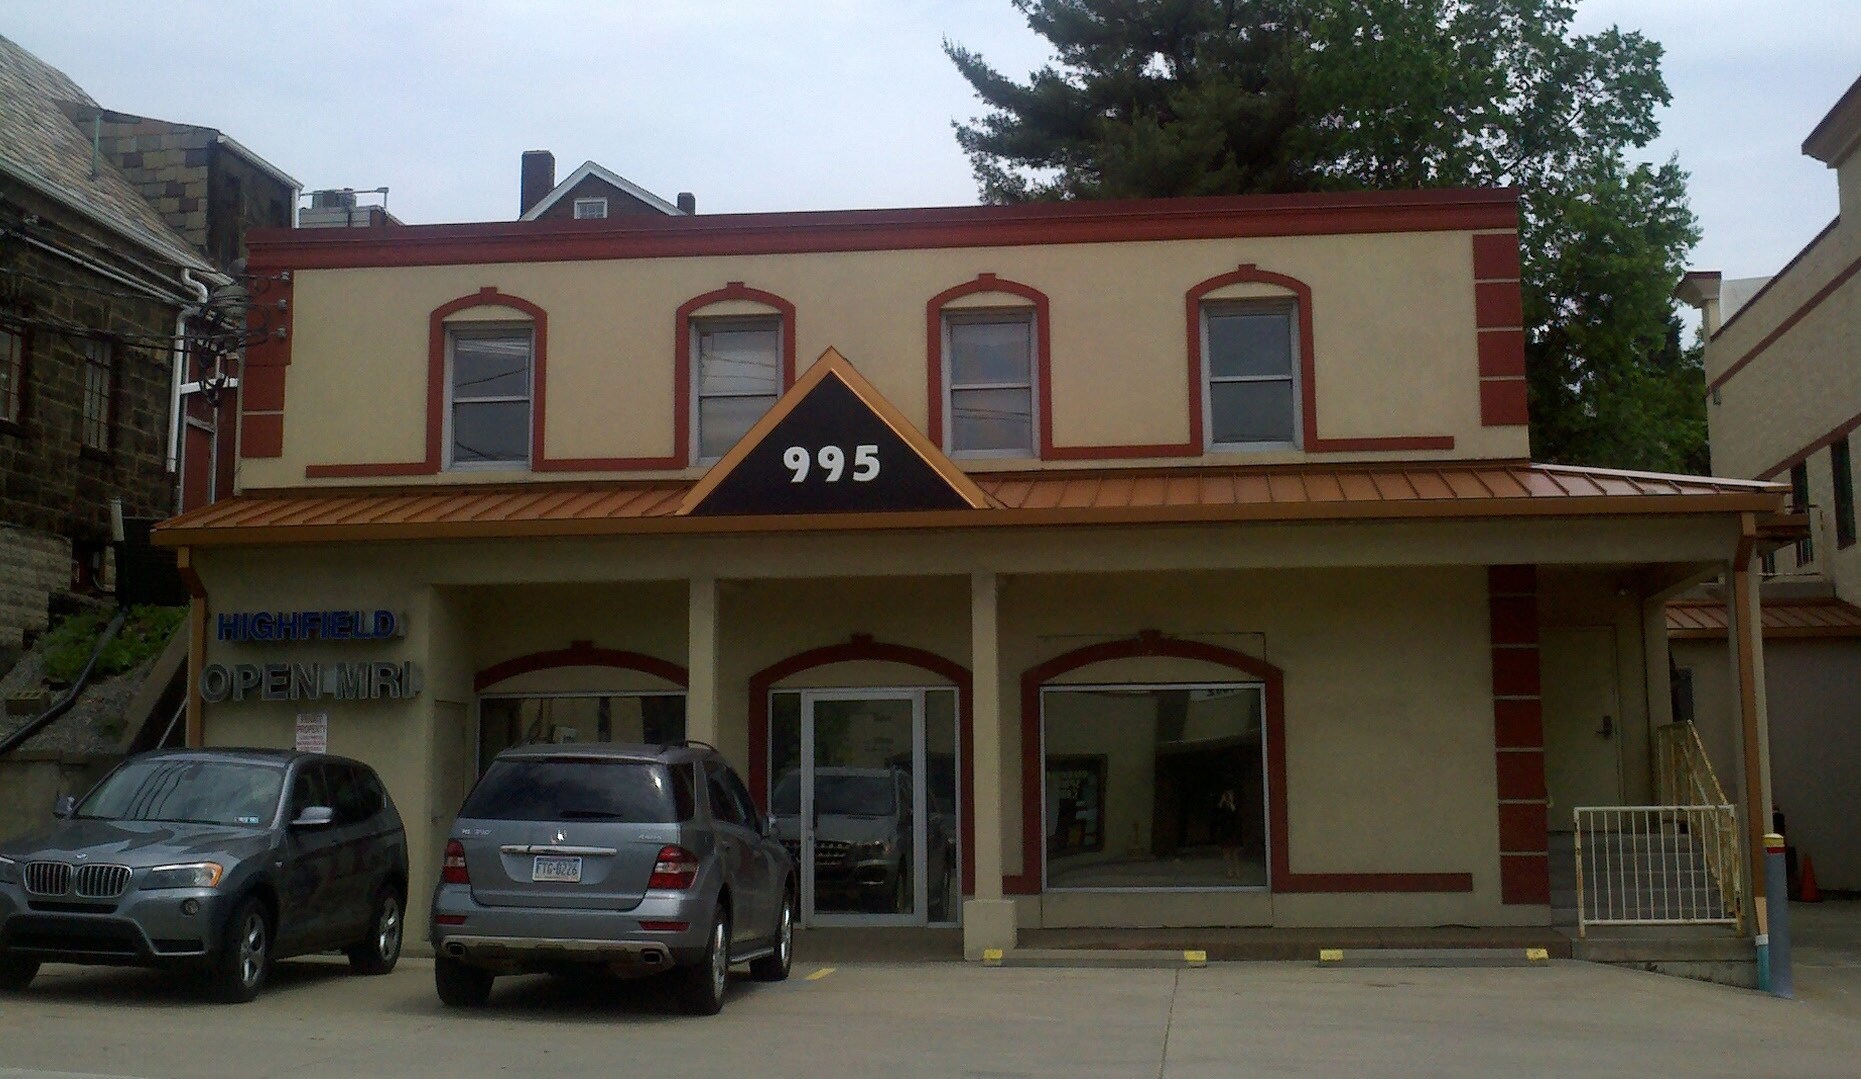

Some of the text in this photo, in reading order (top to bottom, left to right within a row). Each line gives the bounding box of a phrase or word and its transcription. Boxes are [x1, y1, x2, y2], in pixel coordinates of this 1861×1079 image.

[783, 445, 880, 483] 995
[217, 610, 397, 641] HIGHFIELD
[200, 660, 415, 703] OPEN MRI
